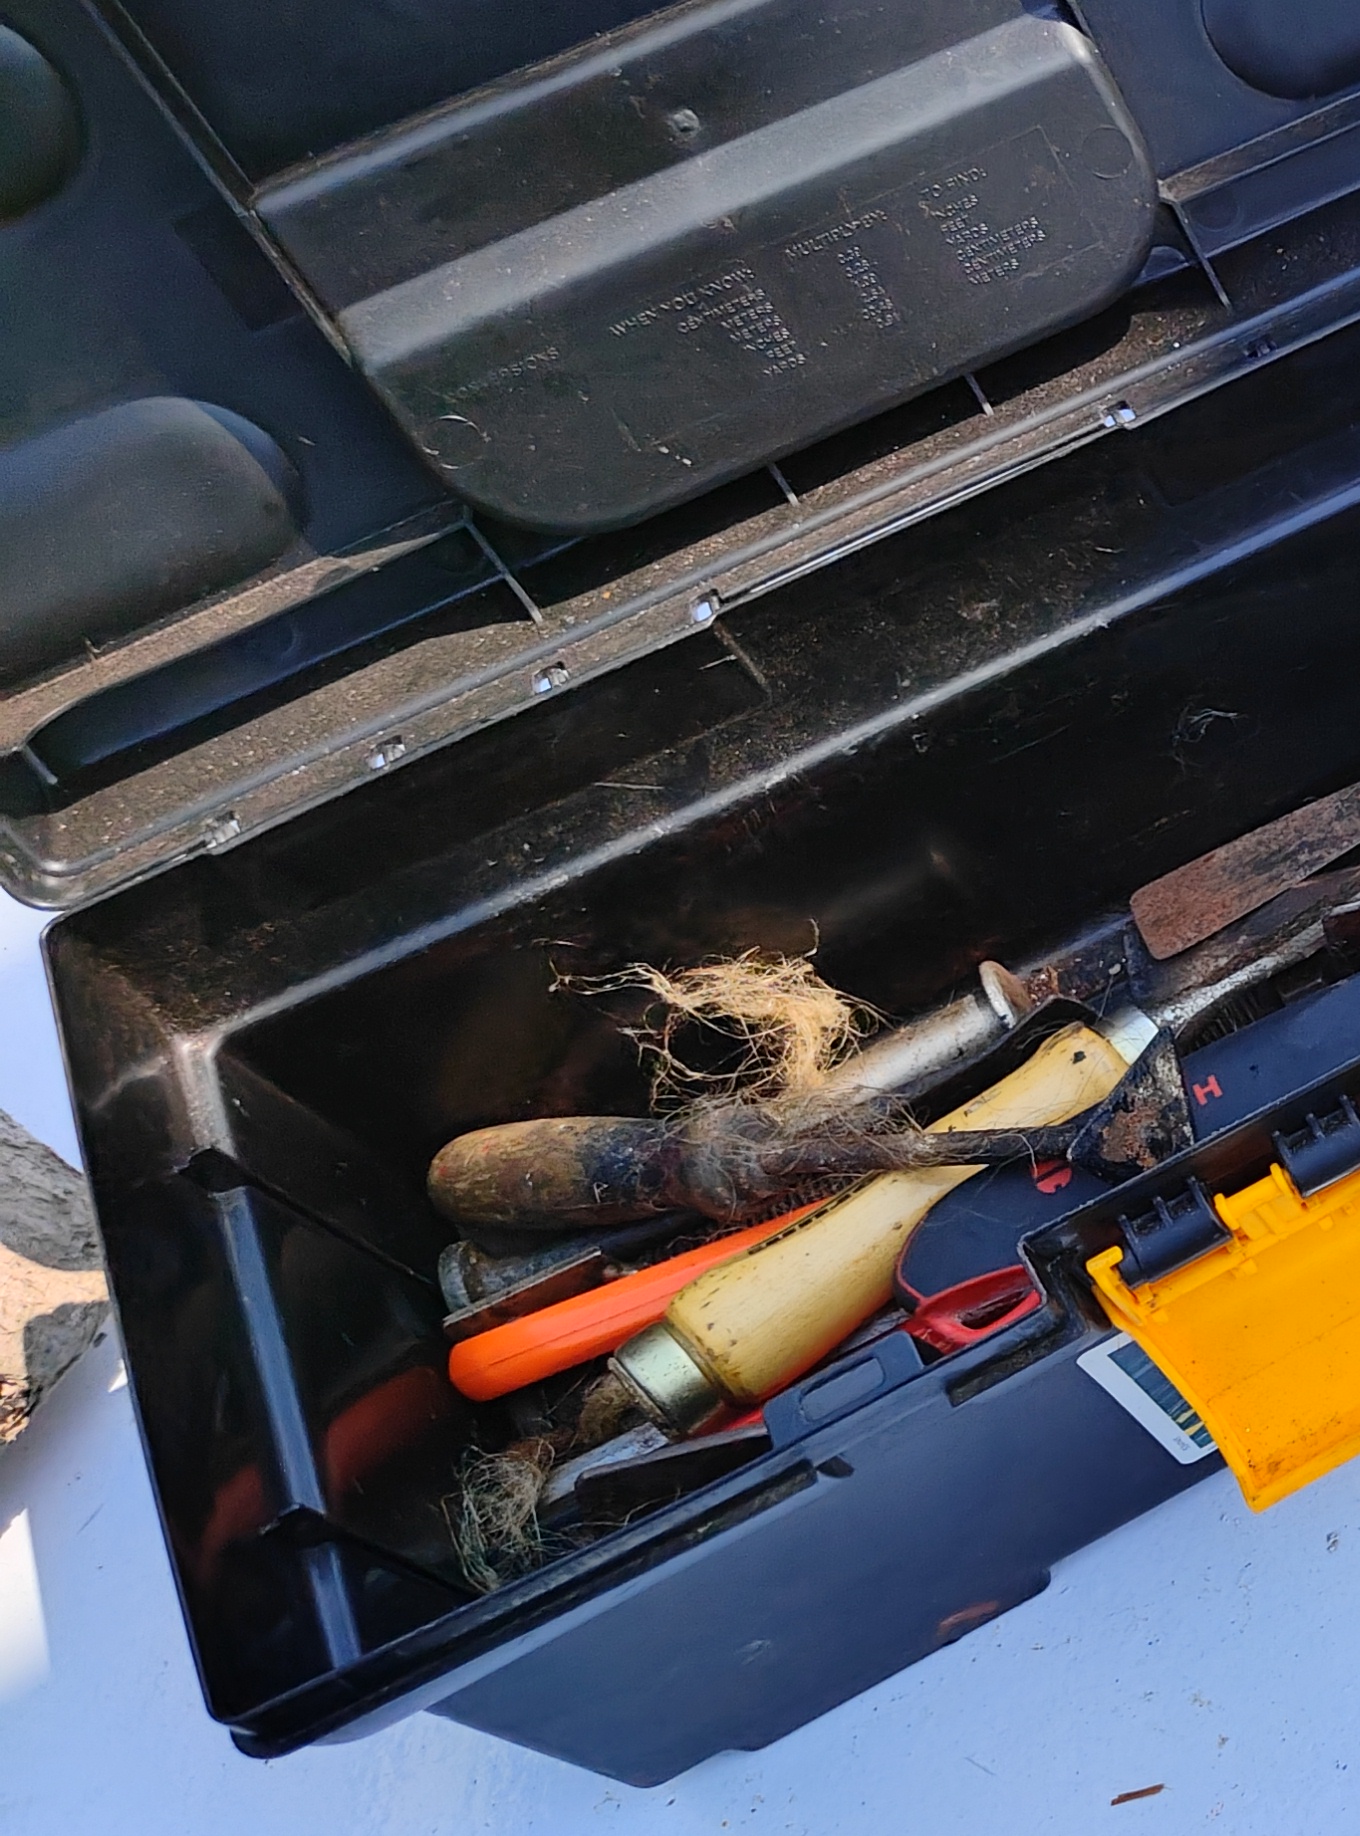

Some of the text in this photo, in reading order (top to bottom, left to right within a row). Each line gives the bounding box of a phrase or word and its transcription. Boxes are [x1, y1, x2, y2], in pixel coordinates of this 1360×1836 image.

[946, 223, 989, 245] YARDS
[957, 216, 1039, 261] CENTIMETERS
[964, 229, 1047, 275] CENTIMETERS
[609, 308, 657, 338] WHEN
[659, 291, 698, 312] YOU
[785, 220, 861, 262] MULTIPLY
[919, 184, 943, 198] TO
[677, 288, 766, 334] CENTIMETERS
[930, 194, 979, 218] INCHES
[968, 258, 1020, 285] METERS
[721, 302, 774, 329] METERS
